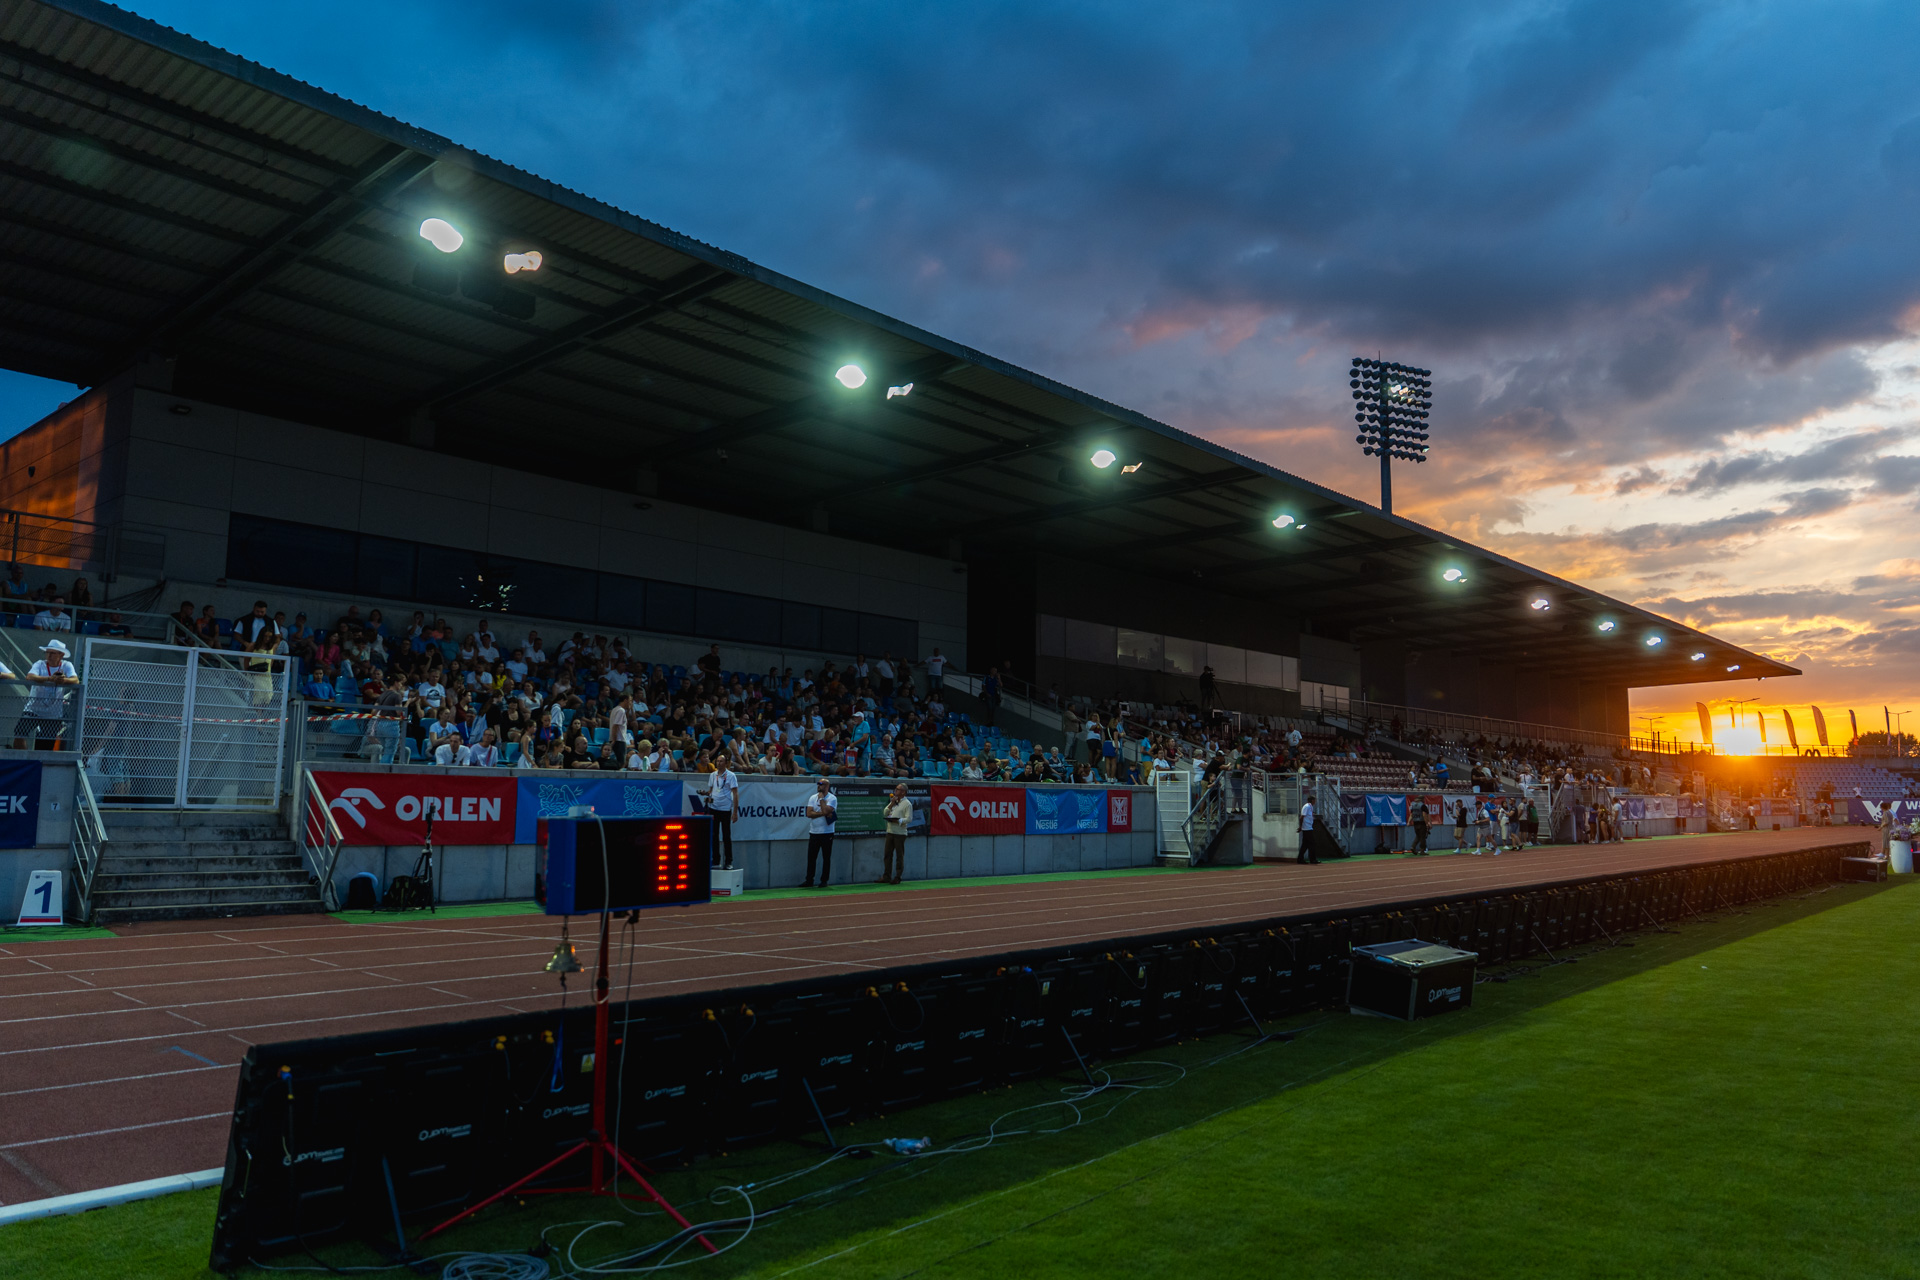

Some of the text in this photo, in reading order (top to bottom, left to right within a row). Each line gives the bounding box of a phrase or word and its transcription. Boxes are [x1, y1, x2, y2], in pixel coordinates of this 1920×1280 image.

[395, 795, 502, 823] ORLEN
[969, 801, 1019, 819] ORLEN
[1035, 819, 1059, 830] Nestlé
[1077, 818, 1099, 829] Nestlé
[34, 881, 52, 914] 1
